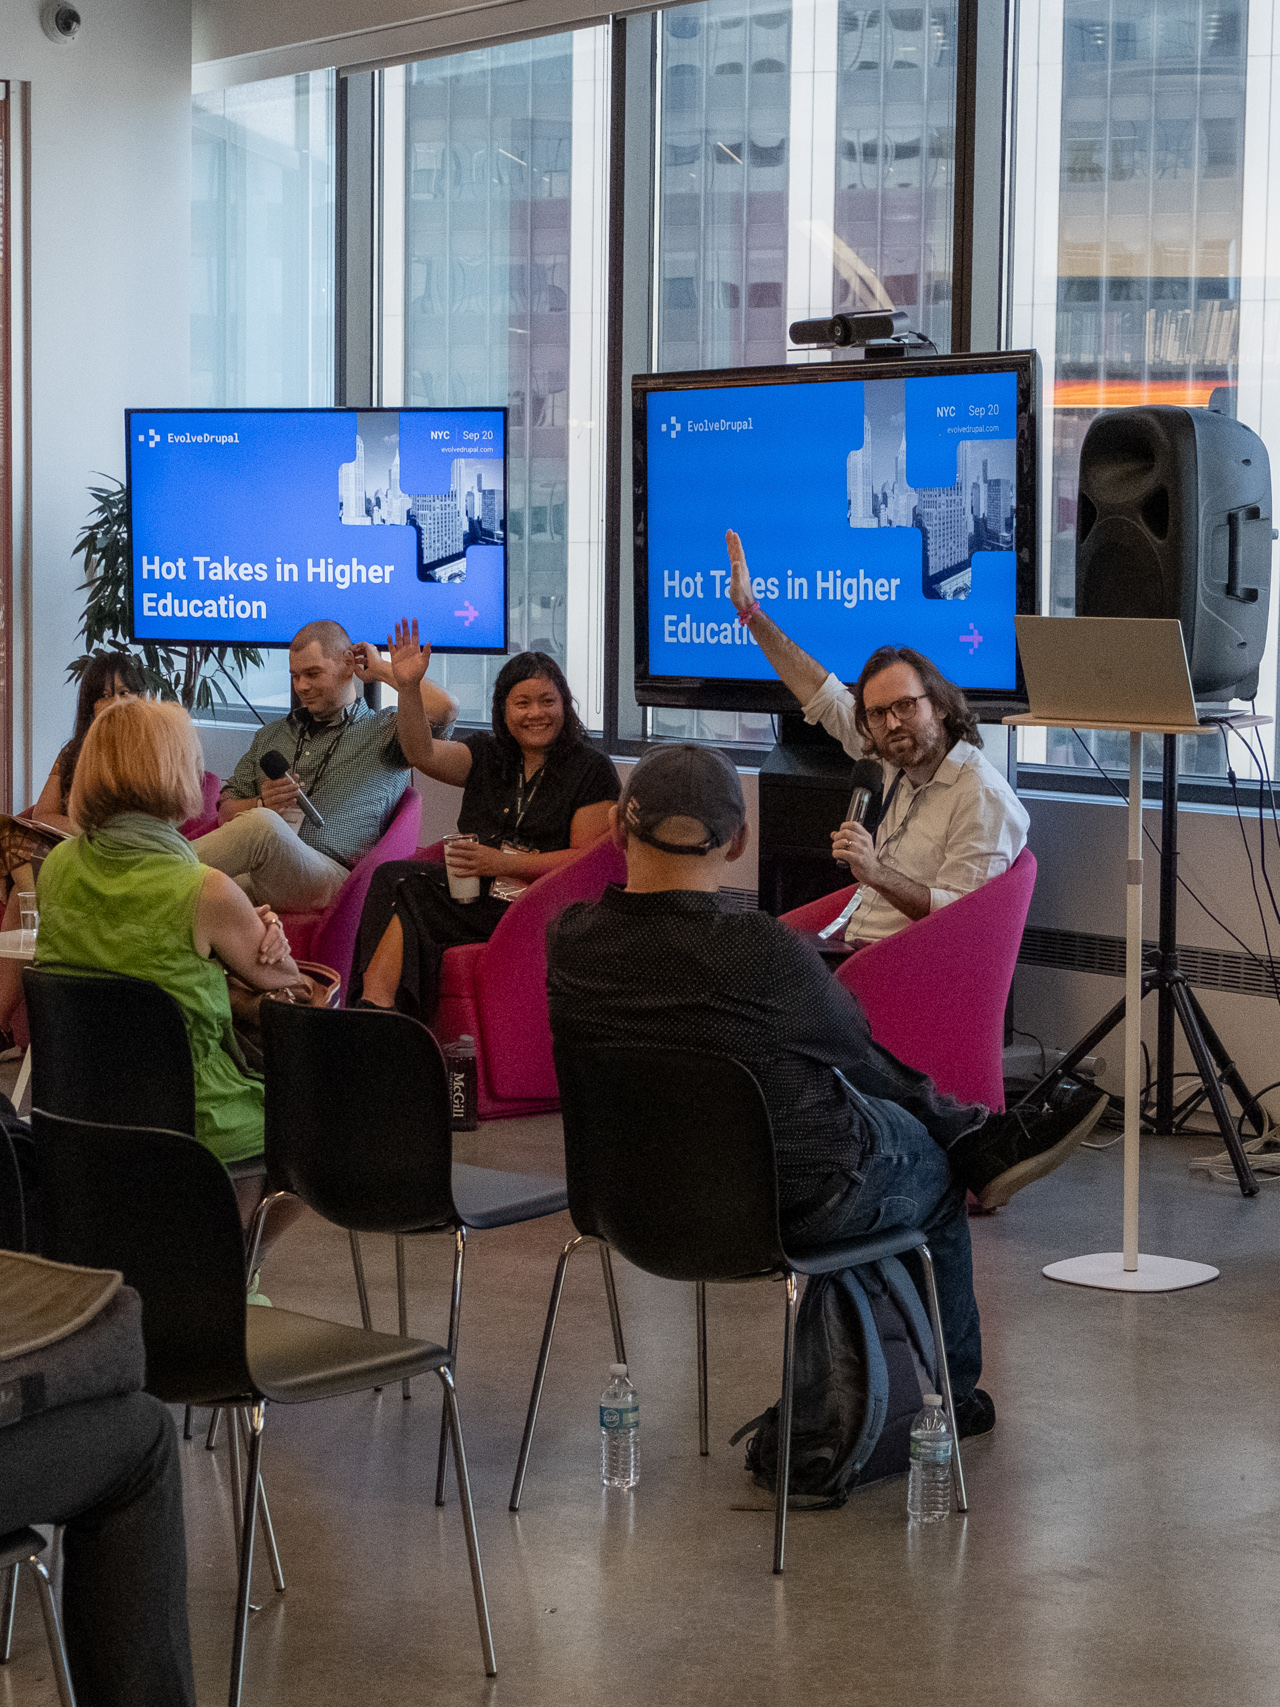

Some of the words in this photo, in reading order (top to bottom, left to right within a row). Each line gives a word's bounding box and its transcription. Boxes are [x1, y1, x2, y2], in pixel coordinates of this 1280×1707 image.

[936, 406, 956, 418] NYC
[968, 405, 986, 419] Sep
[988, 403, 1000, 416] 20
[687, 417, 754, 433] EvolveDrupal
[946, 425, 1000, 434] evolvedrupal.com
[167, 432, 240, 445] EvolveDrupal
[430, 430, 450, 440] NYC
[463, 430, 480, 442] Sep
[482, 430, 494, 440] 20
[441, 446, 494, 454] evolvedrupal.com
[142, 556, 187, 580] Hot
[193, 556, 268, 582] Takes
[276, 557, 299, 582] in
[307, 557, 395, 589] Higher
[663, 570, 703, 599] Hot
[710, 569, 780, 600] Taes
[786, 569, 808, 600] in
[816, 569, 901, 609] Higher
[142, 592, 267, 619] Education
[664, 614, 759, 645] Educati
[452, 1072, 465, 1118] McGill
